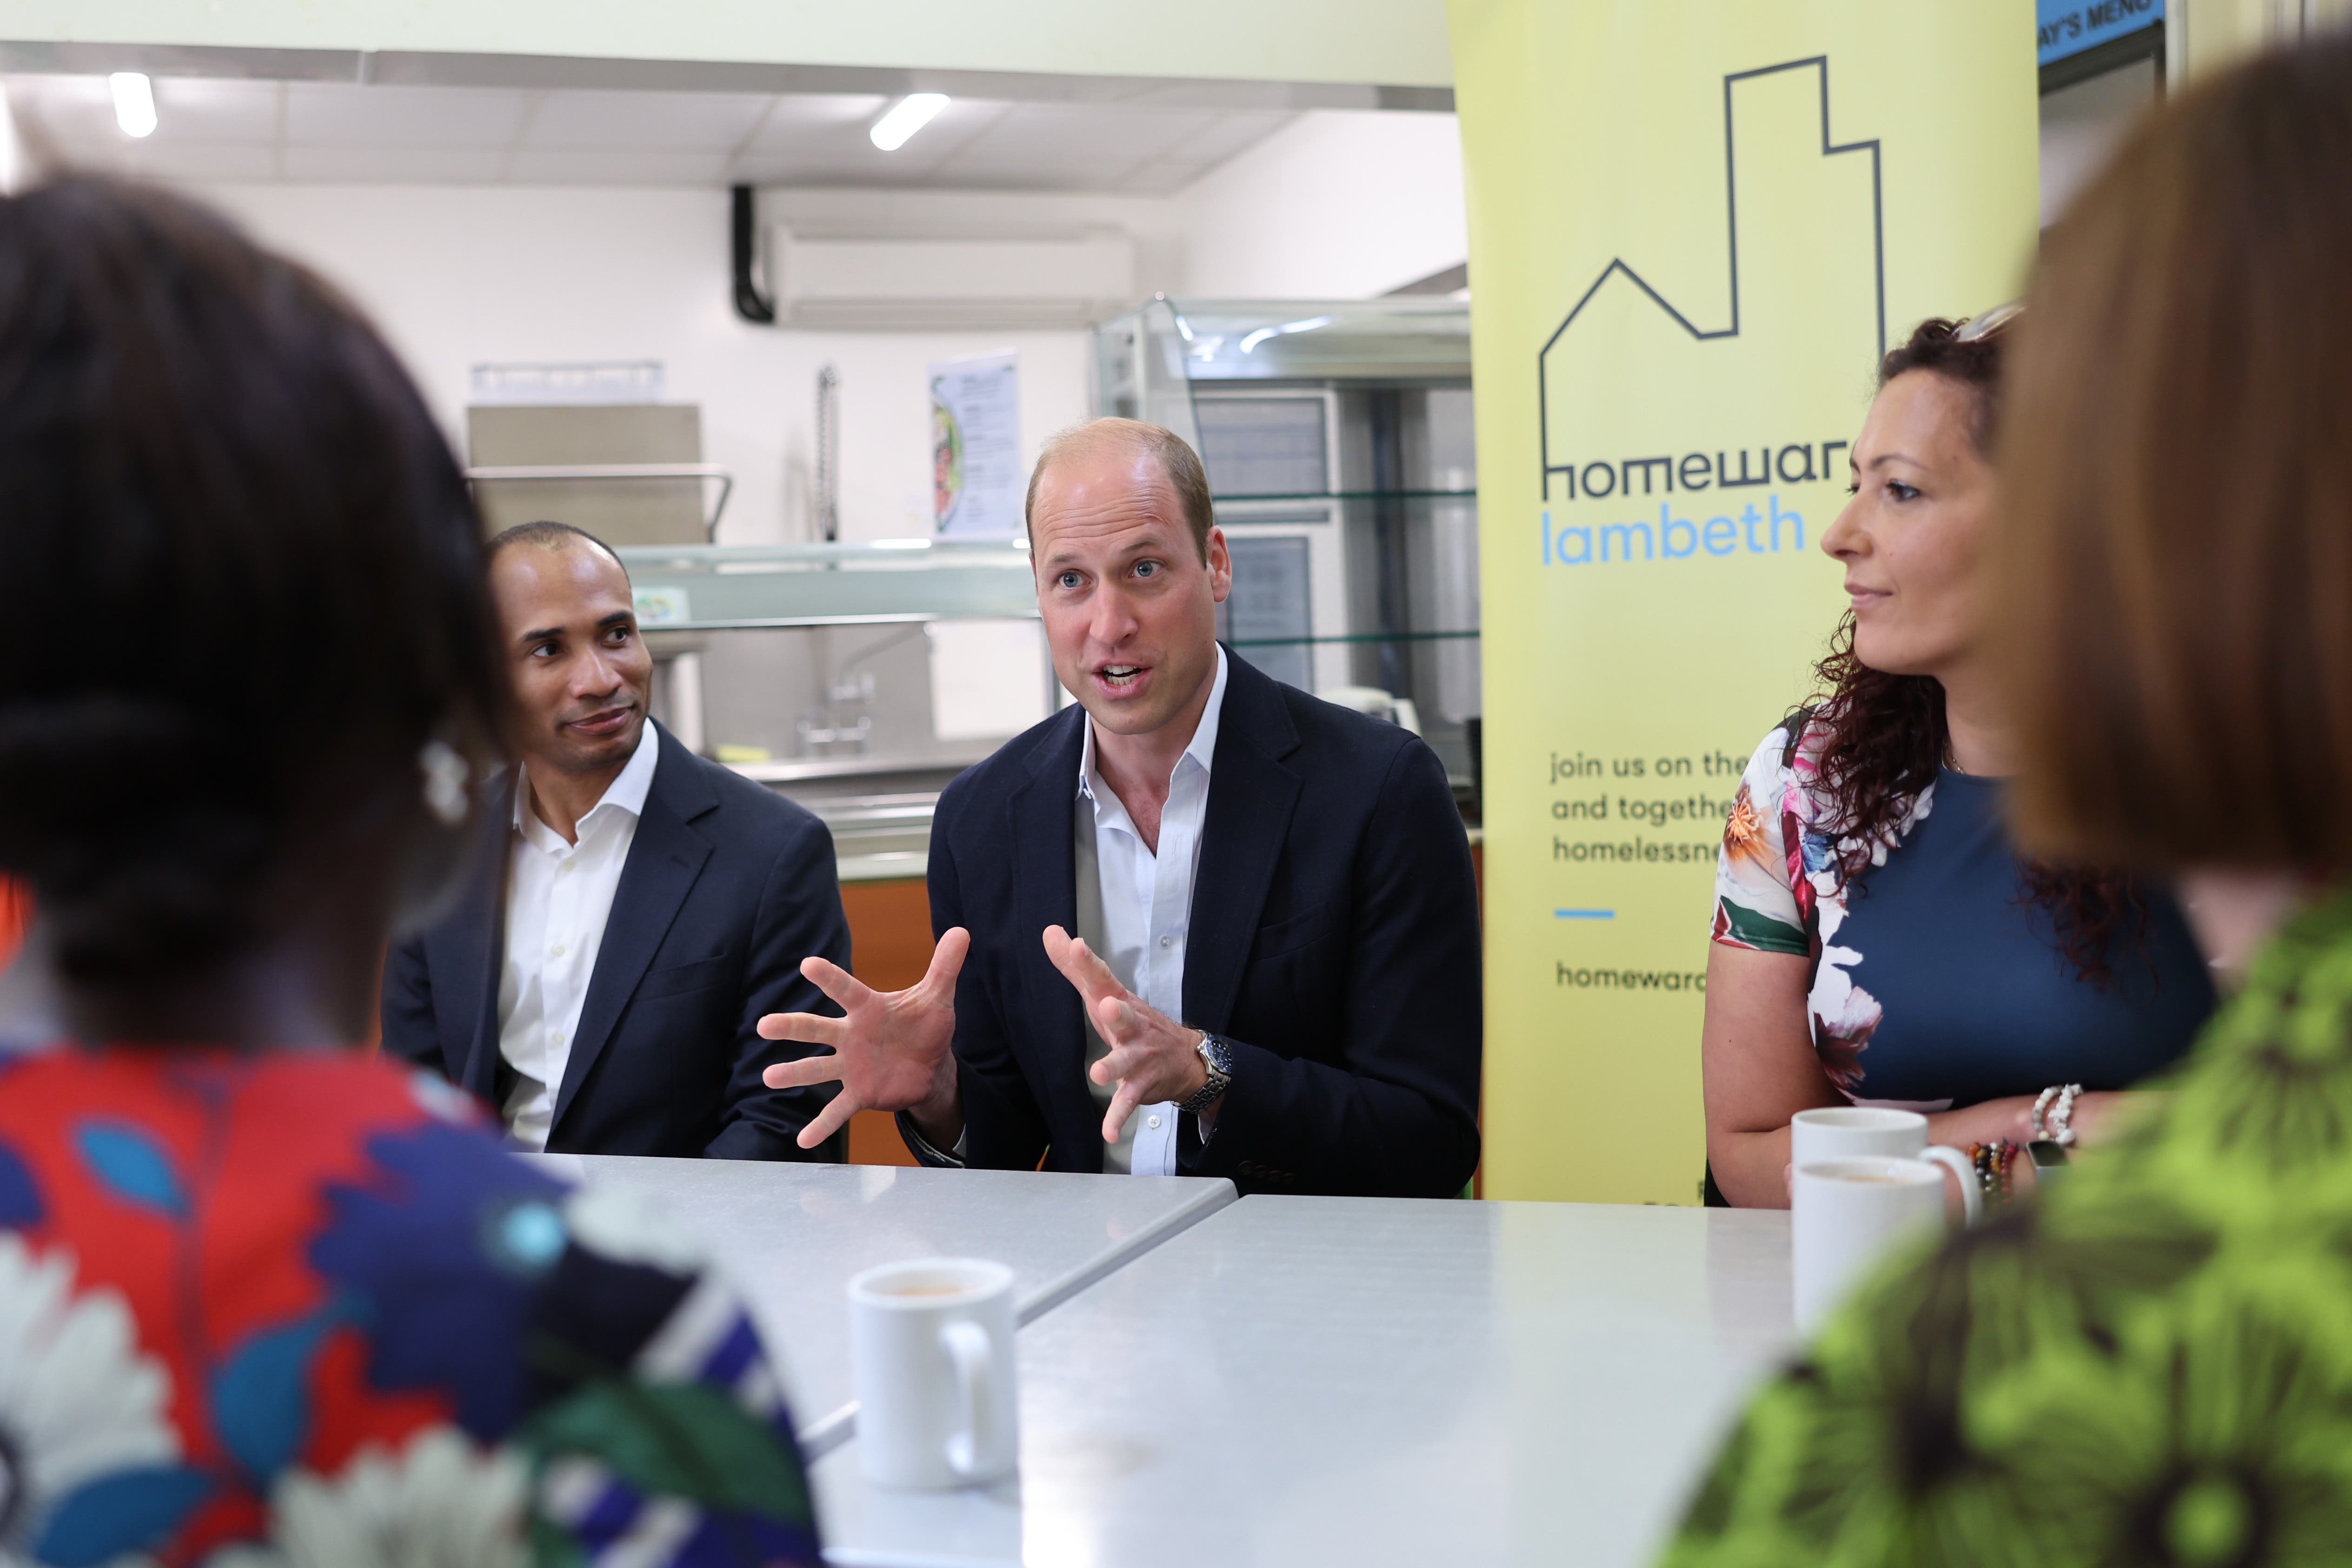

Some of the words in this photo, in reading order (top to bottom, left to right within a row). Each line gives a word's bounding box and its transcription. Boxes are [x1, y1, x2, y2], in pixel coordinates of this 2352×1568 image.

[1542, 494, 1805, 566] lambeth
[1550, 752, 1602, 784] join
[1614, 757, 1645, 777] us
[1656, 756, 1692, 777] on
[1703, 749, 1749, 776] the
[1552, 794, 1608, 820] and
